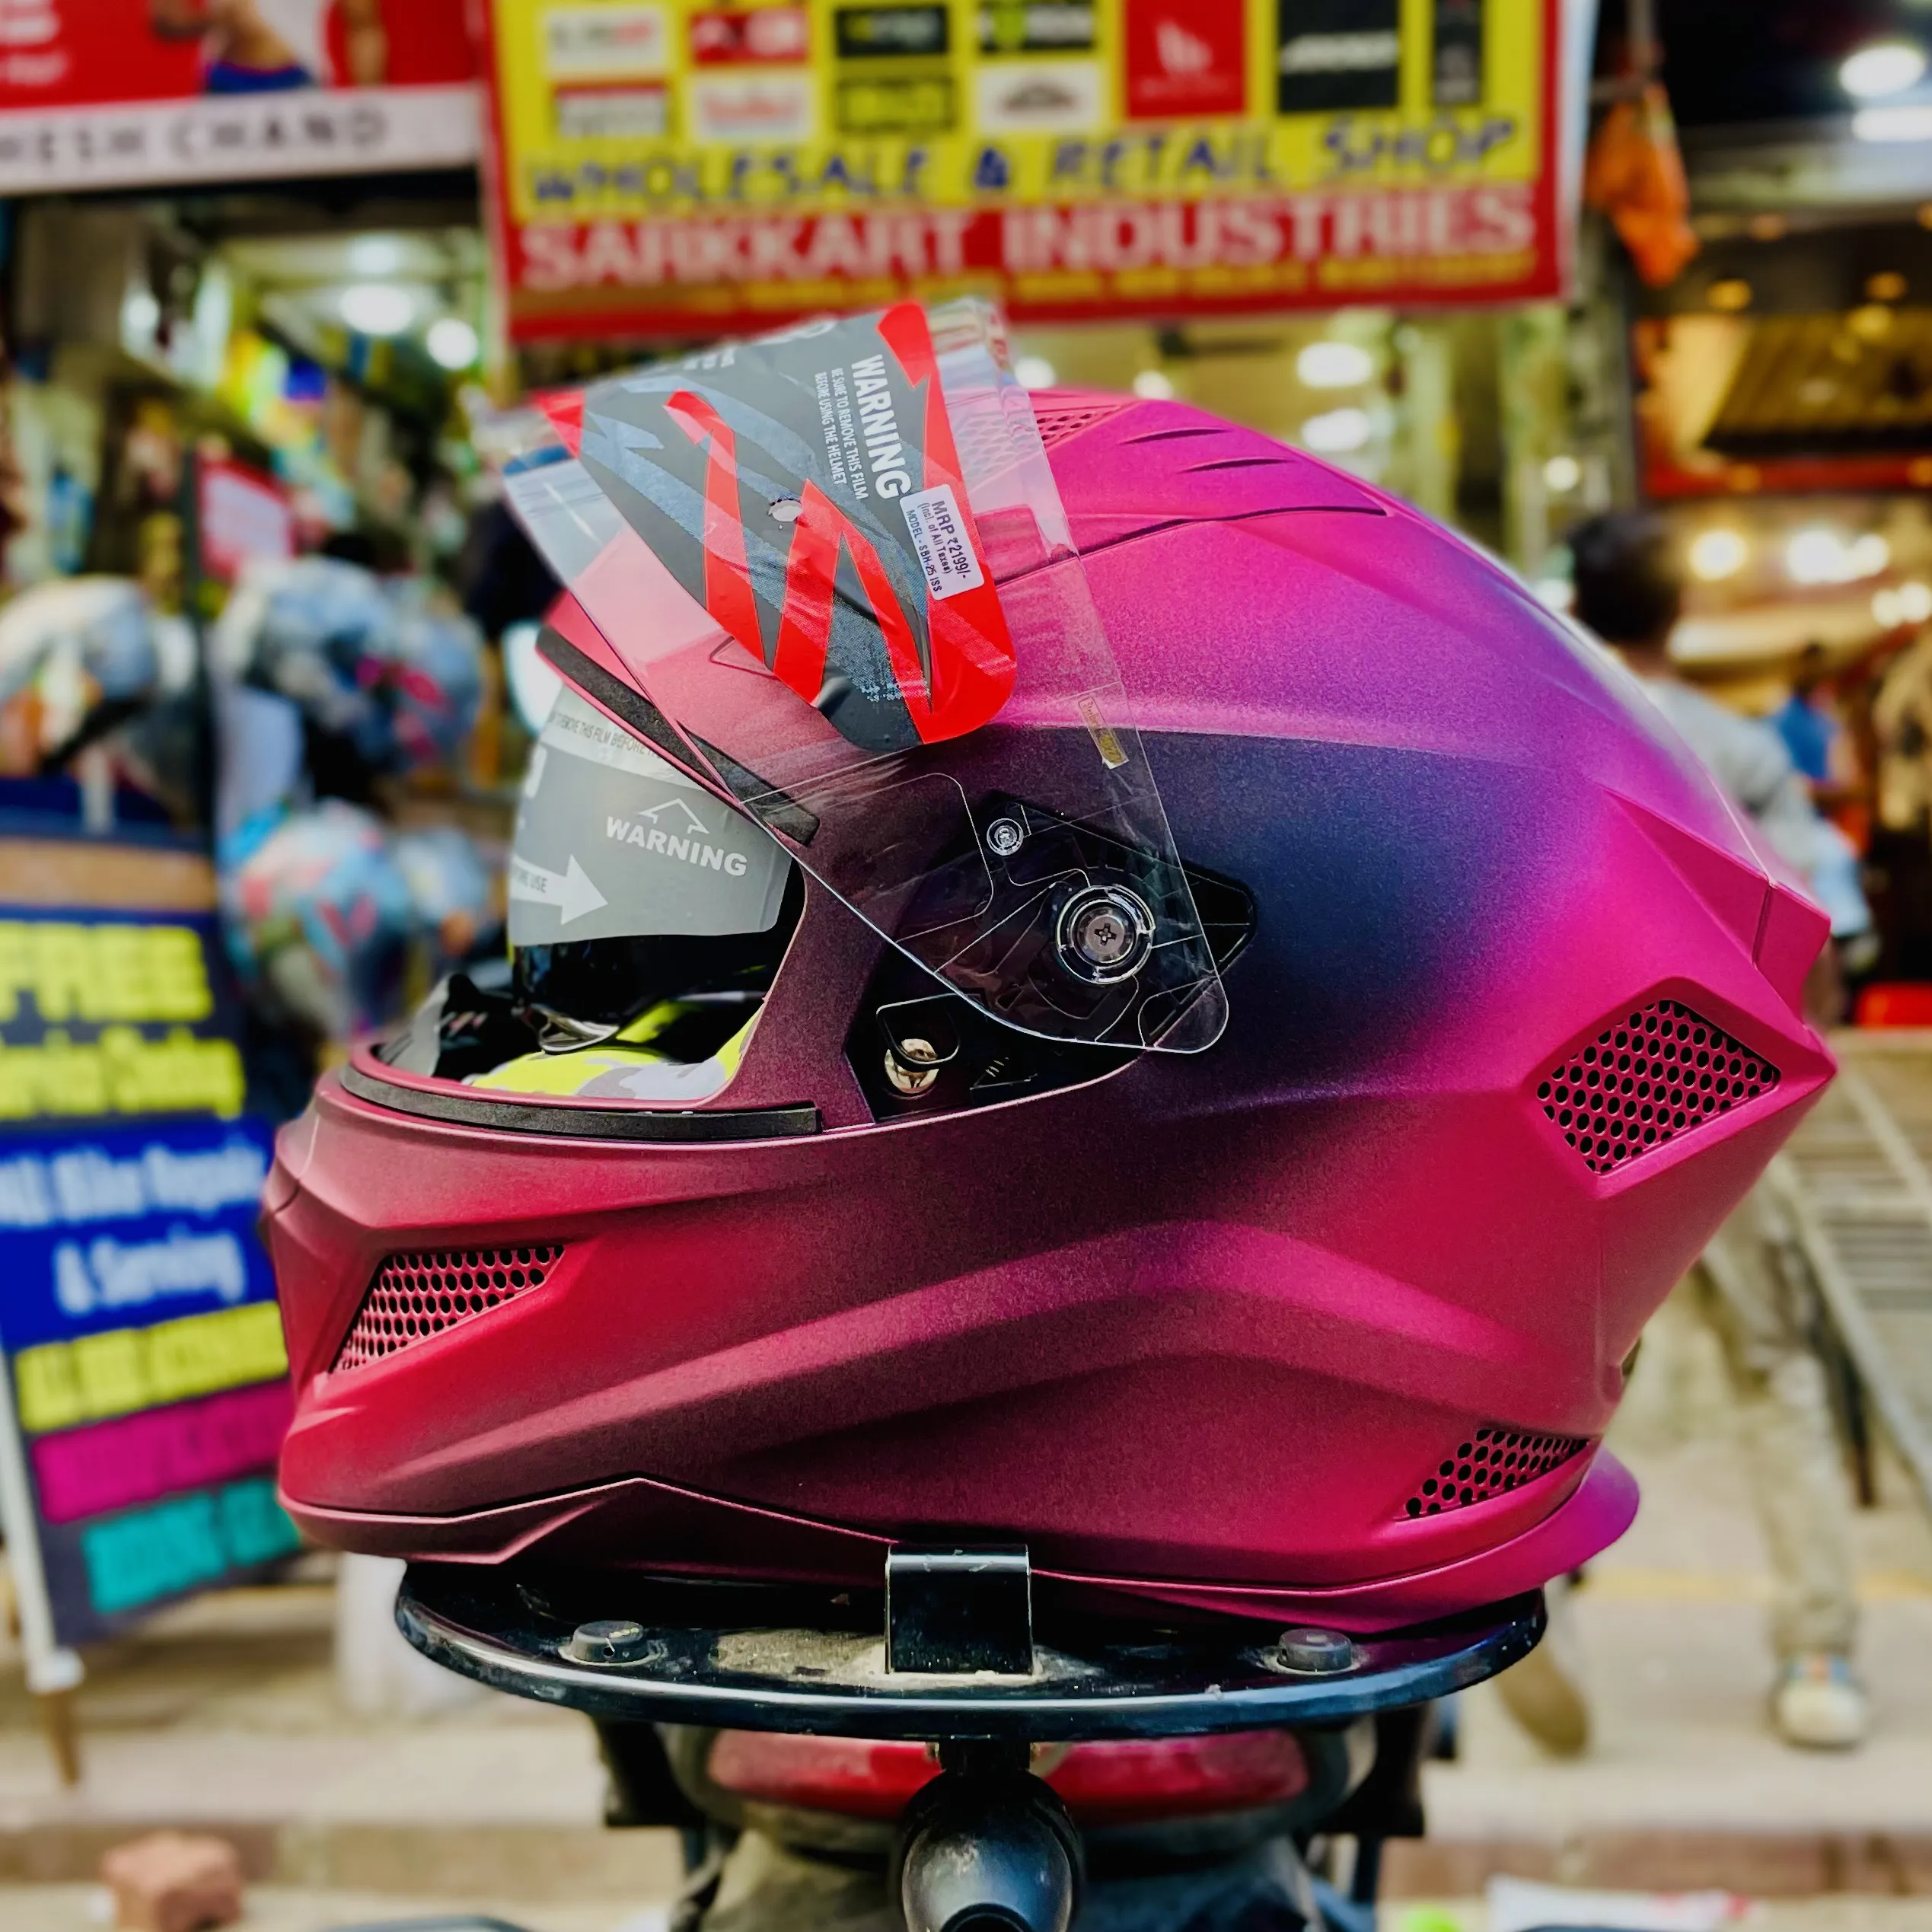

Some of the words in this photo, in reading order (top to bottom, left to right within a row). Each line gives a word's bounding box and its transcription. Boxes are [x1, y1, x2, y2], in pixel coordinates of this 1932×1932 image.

[531, 145, 929, 204] WHOLESALE
[971, 145, 1009, 192] &
[1051, 126, 1273, 192] RETAIL
[1324, 114, 1516, 177] SHOP
[1001, 186, 1536, 271] INDUSTRIES
[815, 371, 830, 399] BEFORE
[831, 368, 843, 378] BE
[833, 378, 847, 397] SURE
[819, 397, 834, 426] USING
[836, 395, 850, 409] TO
[824, 424, 838, 445] THE
[838, 408, 857, 448] REMOVE
[851, 354, 912, 499] WARNING
[827, 443, 847, 485] HELMET
[846, 447, 862, 473] THIS
[850, 471, 869, 499] FILM
[906, 509, 923, 539] MODEL
[928, 524, 939, 533] of
[932, 500, 955, 535] MRP
[932, 534, 944, 546] All
[936, 546, 954, 574] Taxes)
[579, 721, 593, 738] THIS
[593, 725, 610, 744] FILM
[611, 732, 646, 754] BEFORE
[607, 816, 748, 876] WARNING
